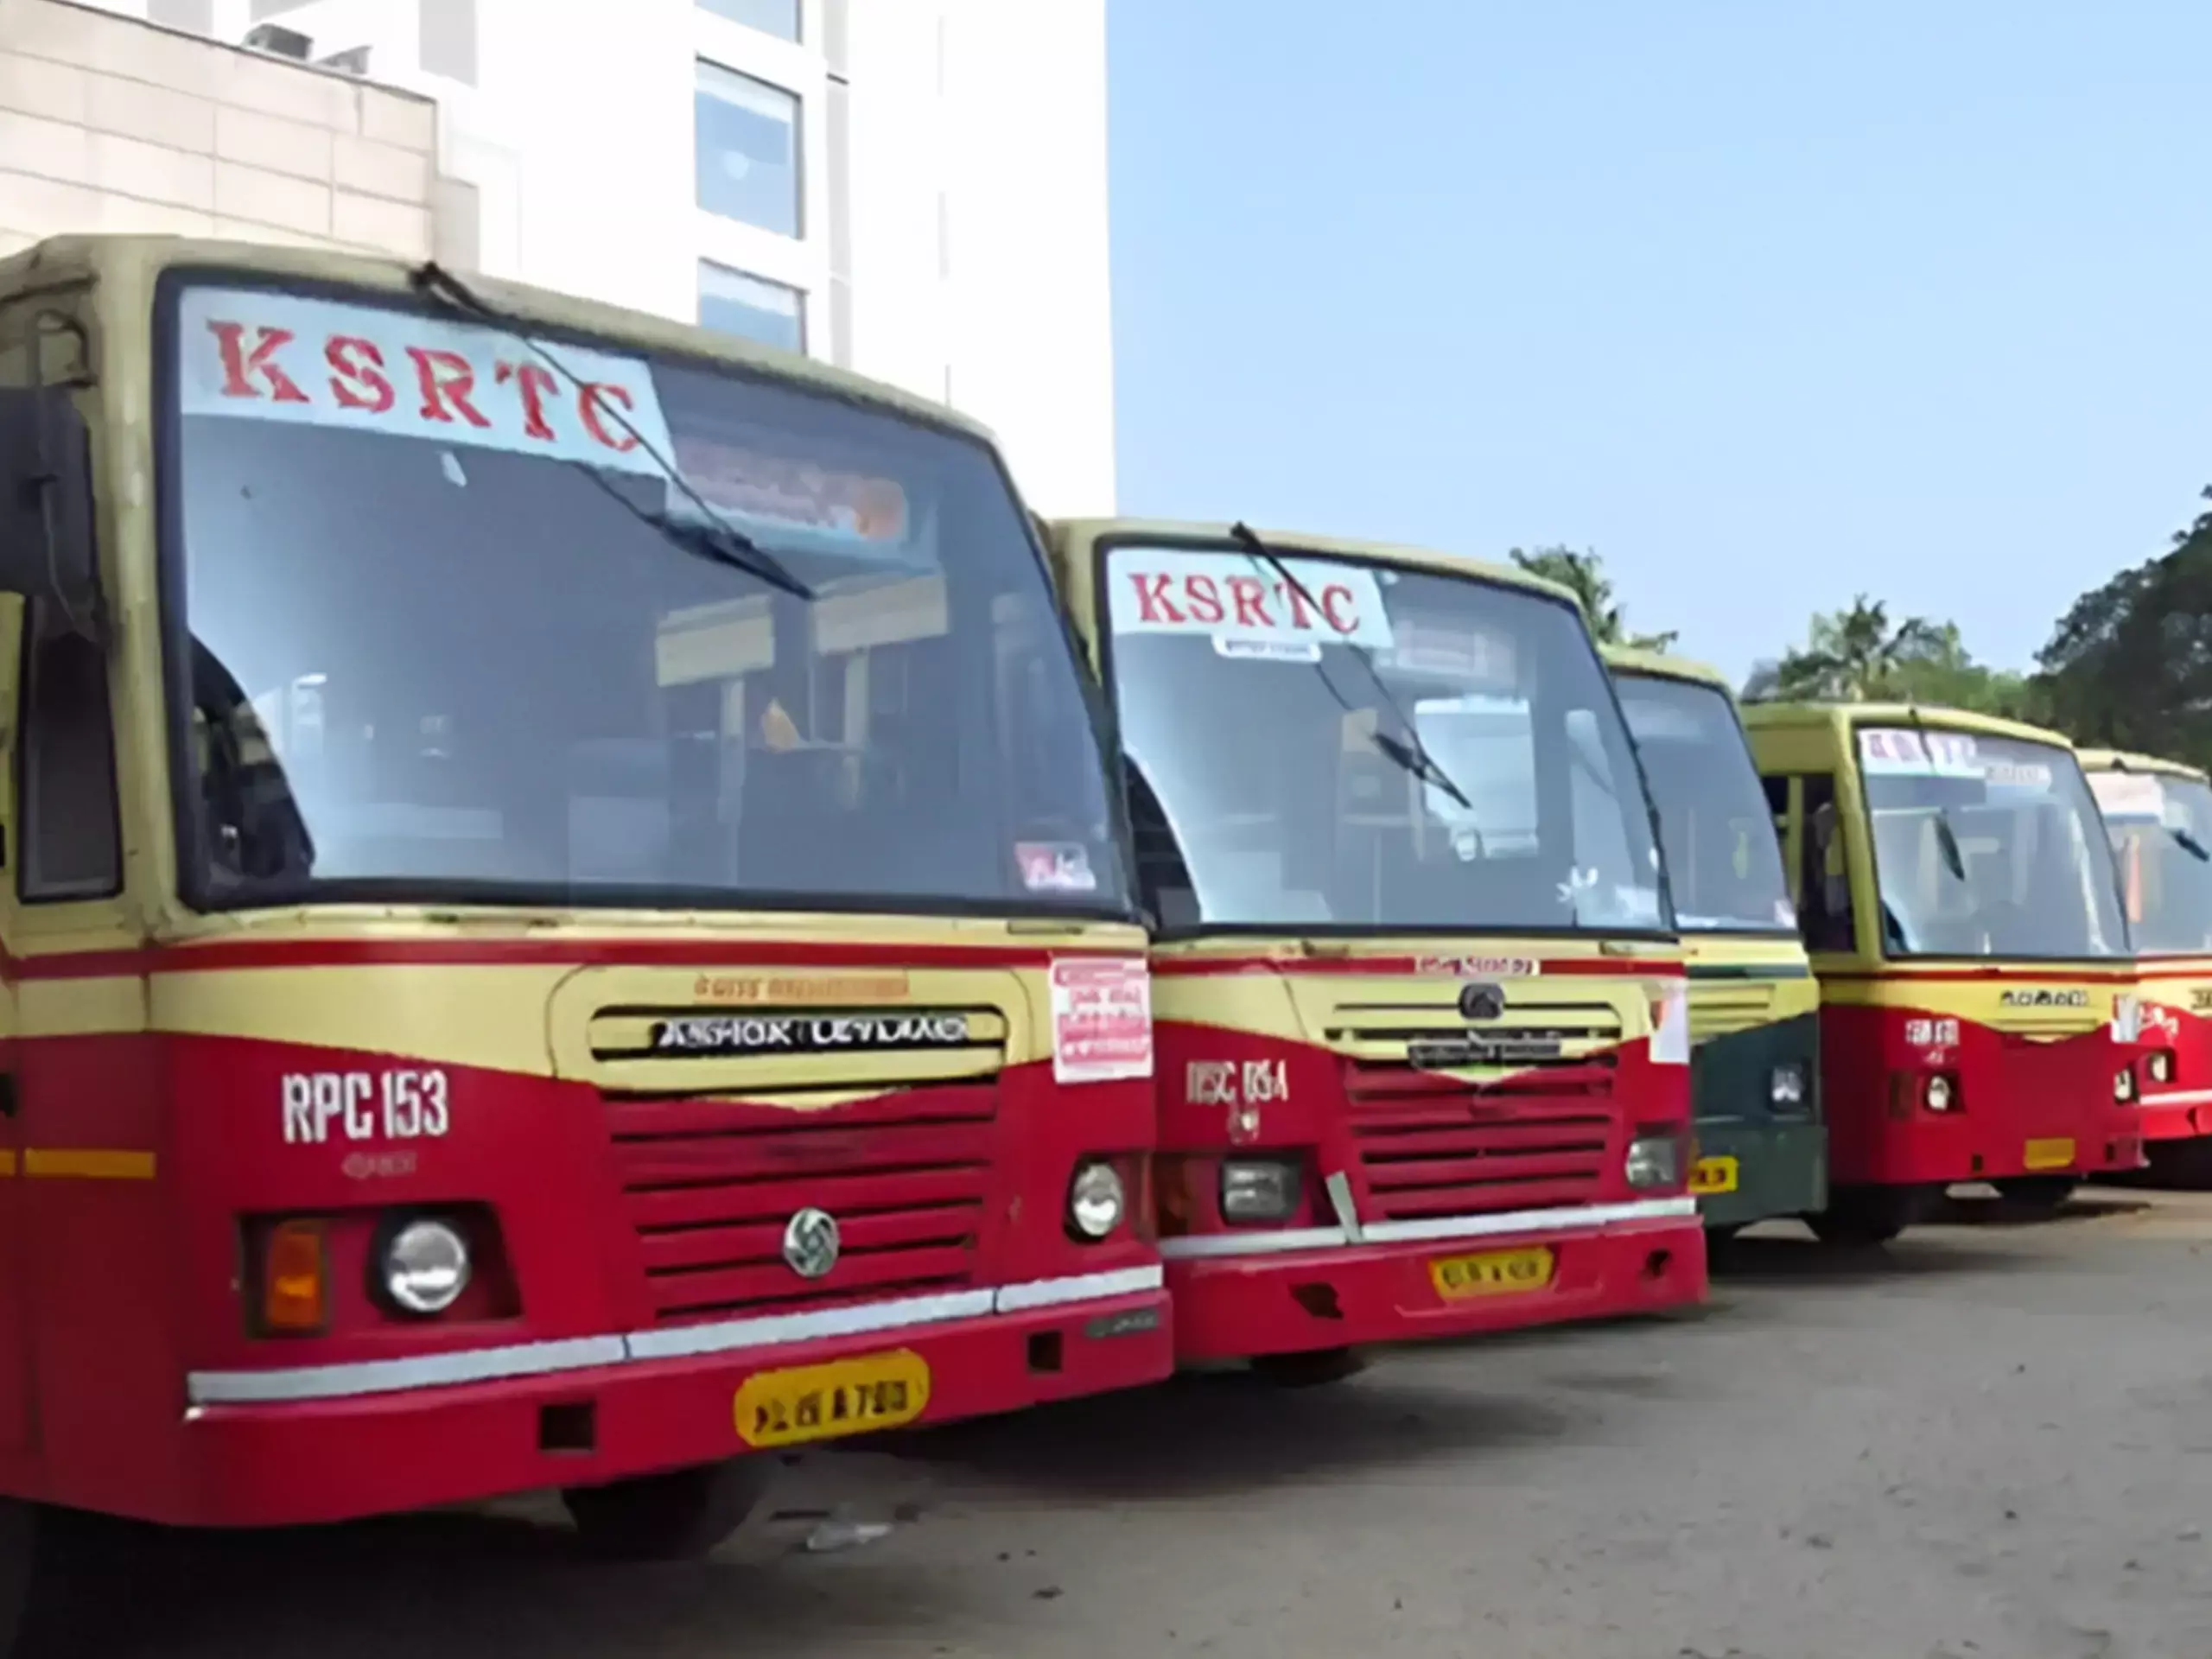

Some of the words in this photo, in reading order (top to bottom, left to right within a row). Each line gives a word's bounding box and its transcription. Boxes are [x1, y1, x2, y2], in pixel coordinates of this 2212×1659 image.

[207, 318, 638, 452] KSRTC
[1128, 572, 1360, 634] KSRTC
[281, 1071, 375, 1144] RPC
[380, 1069, 448, 1139] 153
